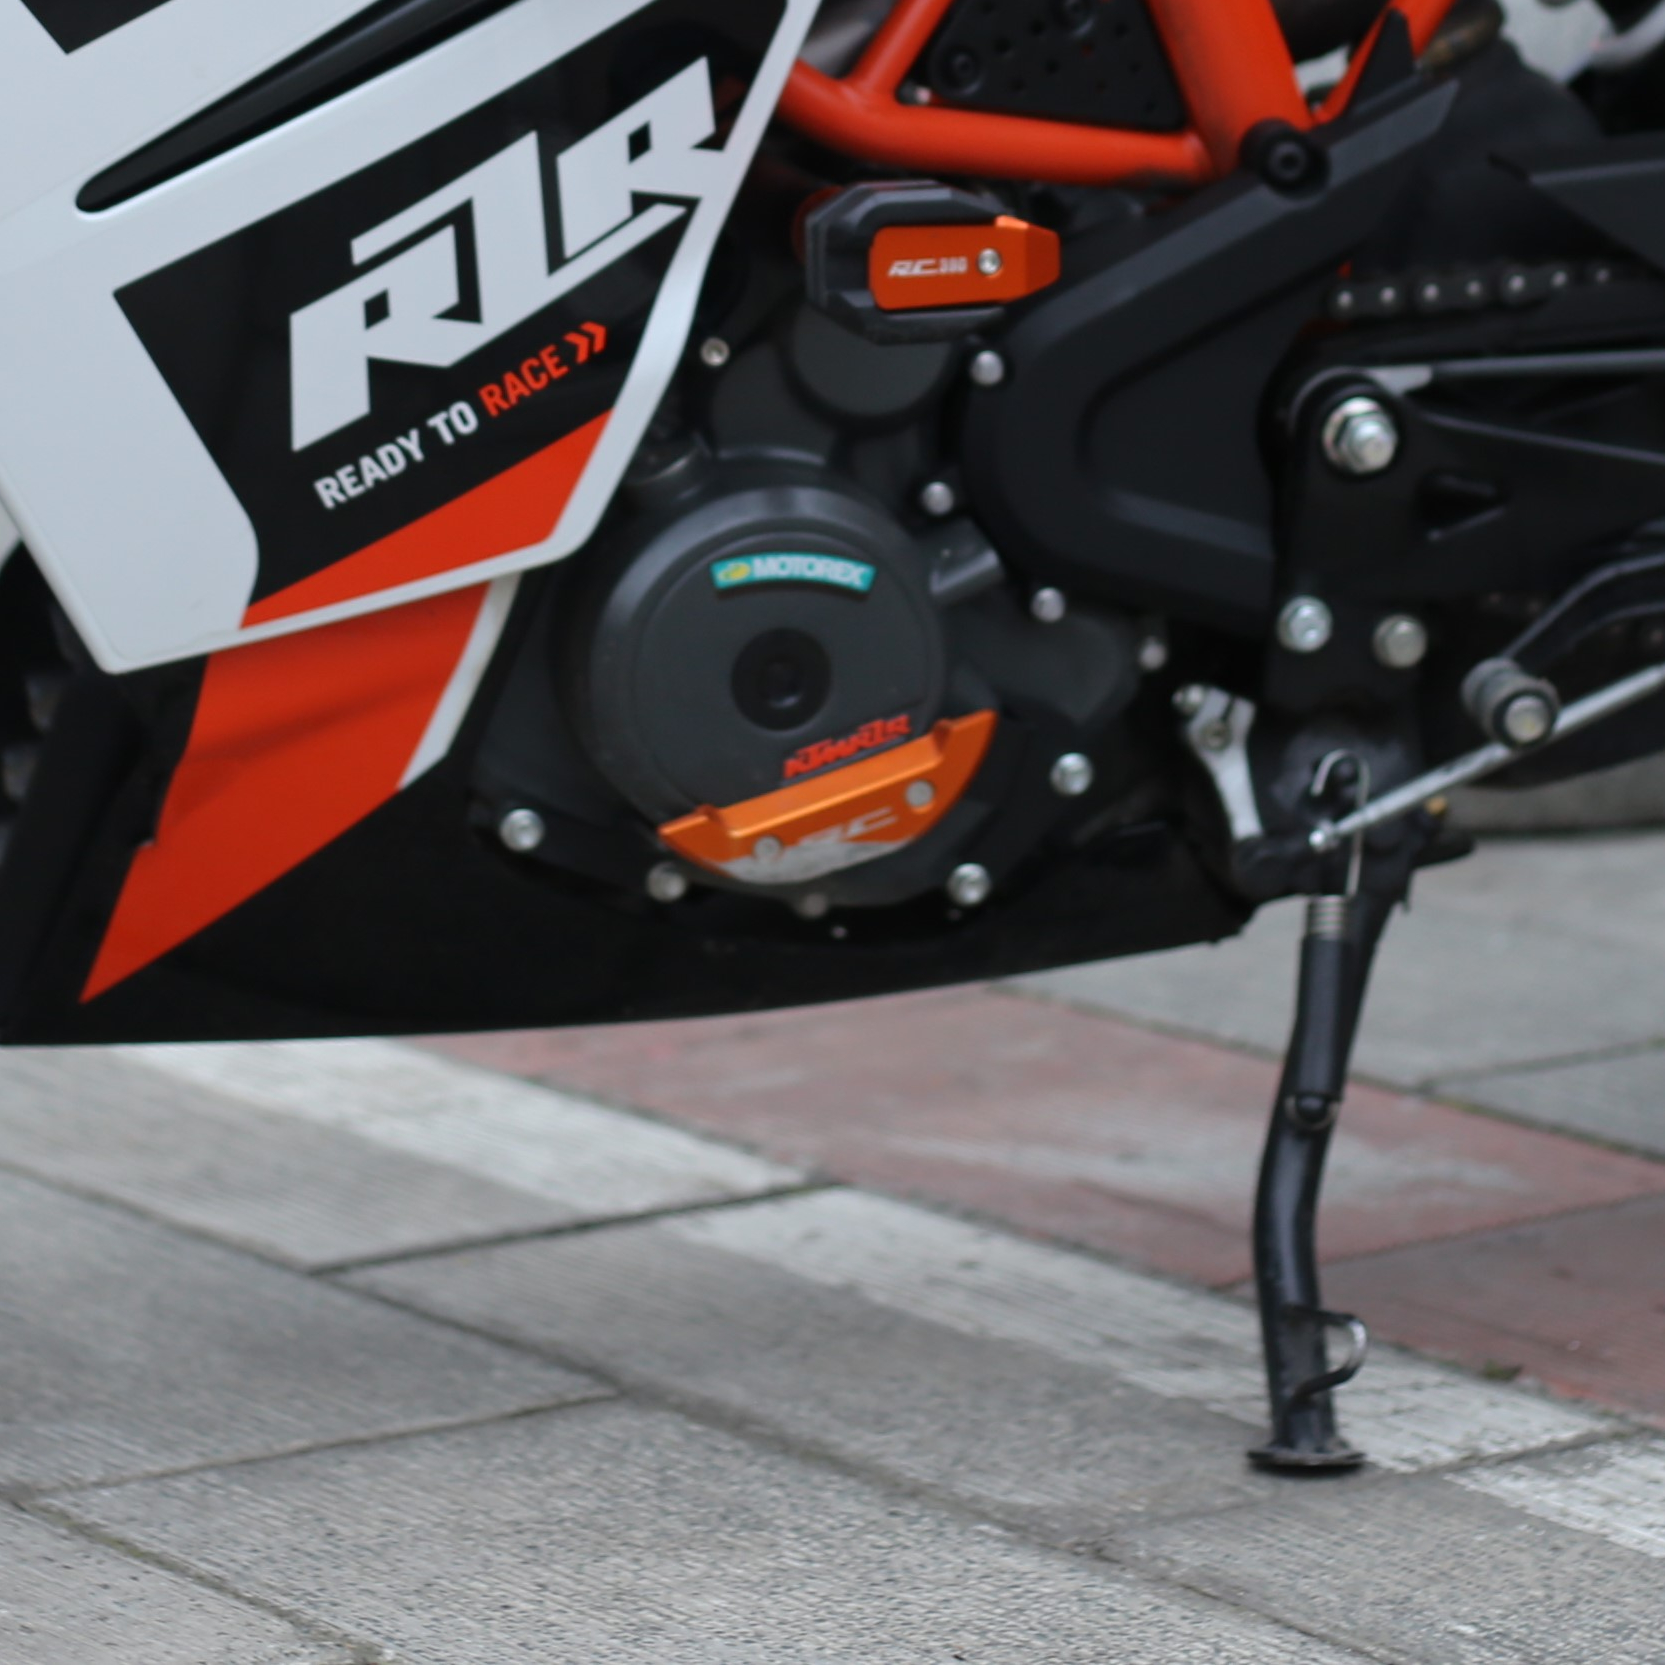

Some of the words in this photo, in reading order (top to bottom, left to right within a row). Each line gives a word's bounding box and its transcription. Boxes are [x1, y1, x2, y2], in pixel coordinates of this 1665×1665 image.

[313, 428, 426, 509] READY
[427, 403, 480, 446] TO
[480, 344, 570, 418] RACE
[752, 555, 866, 586] MOTOREX
